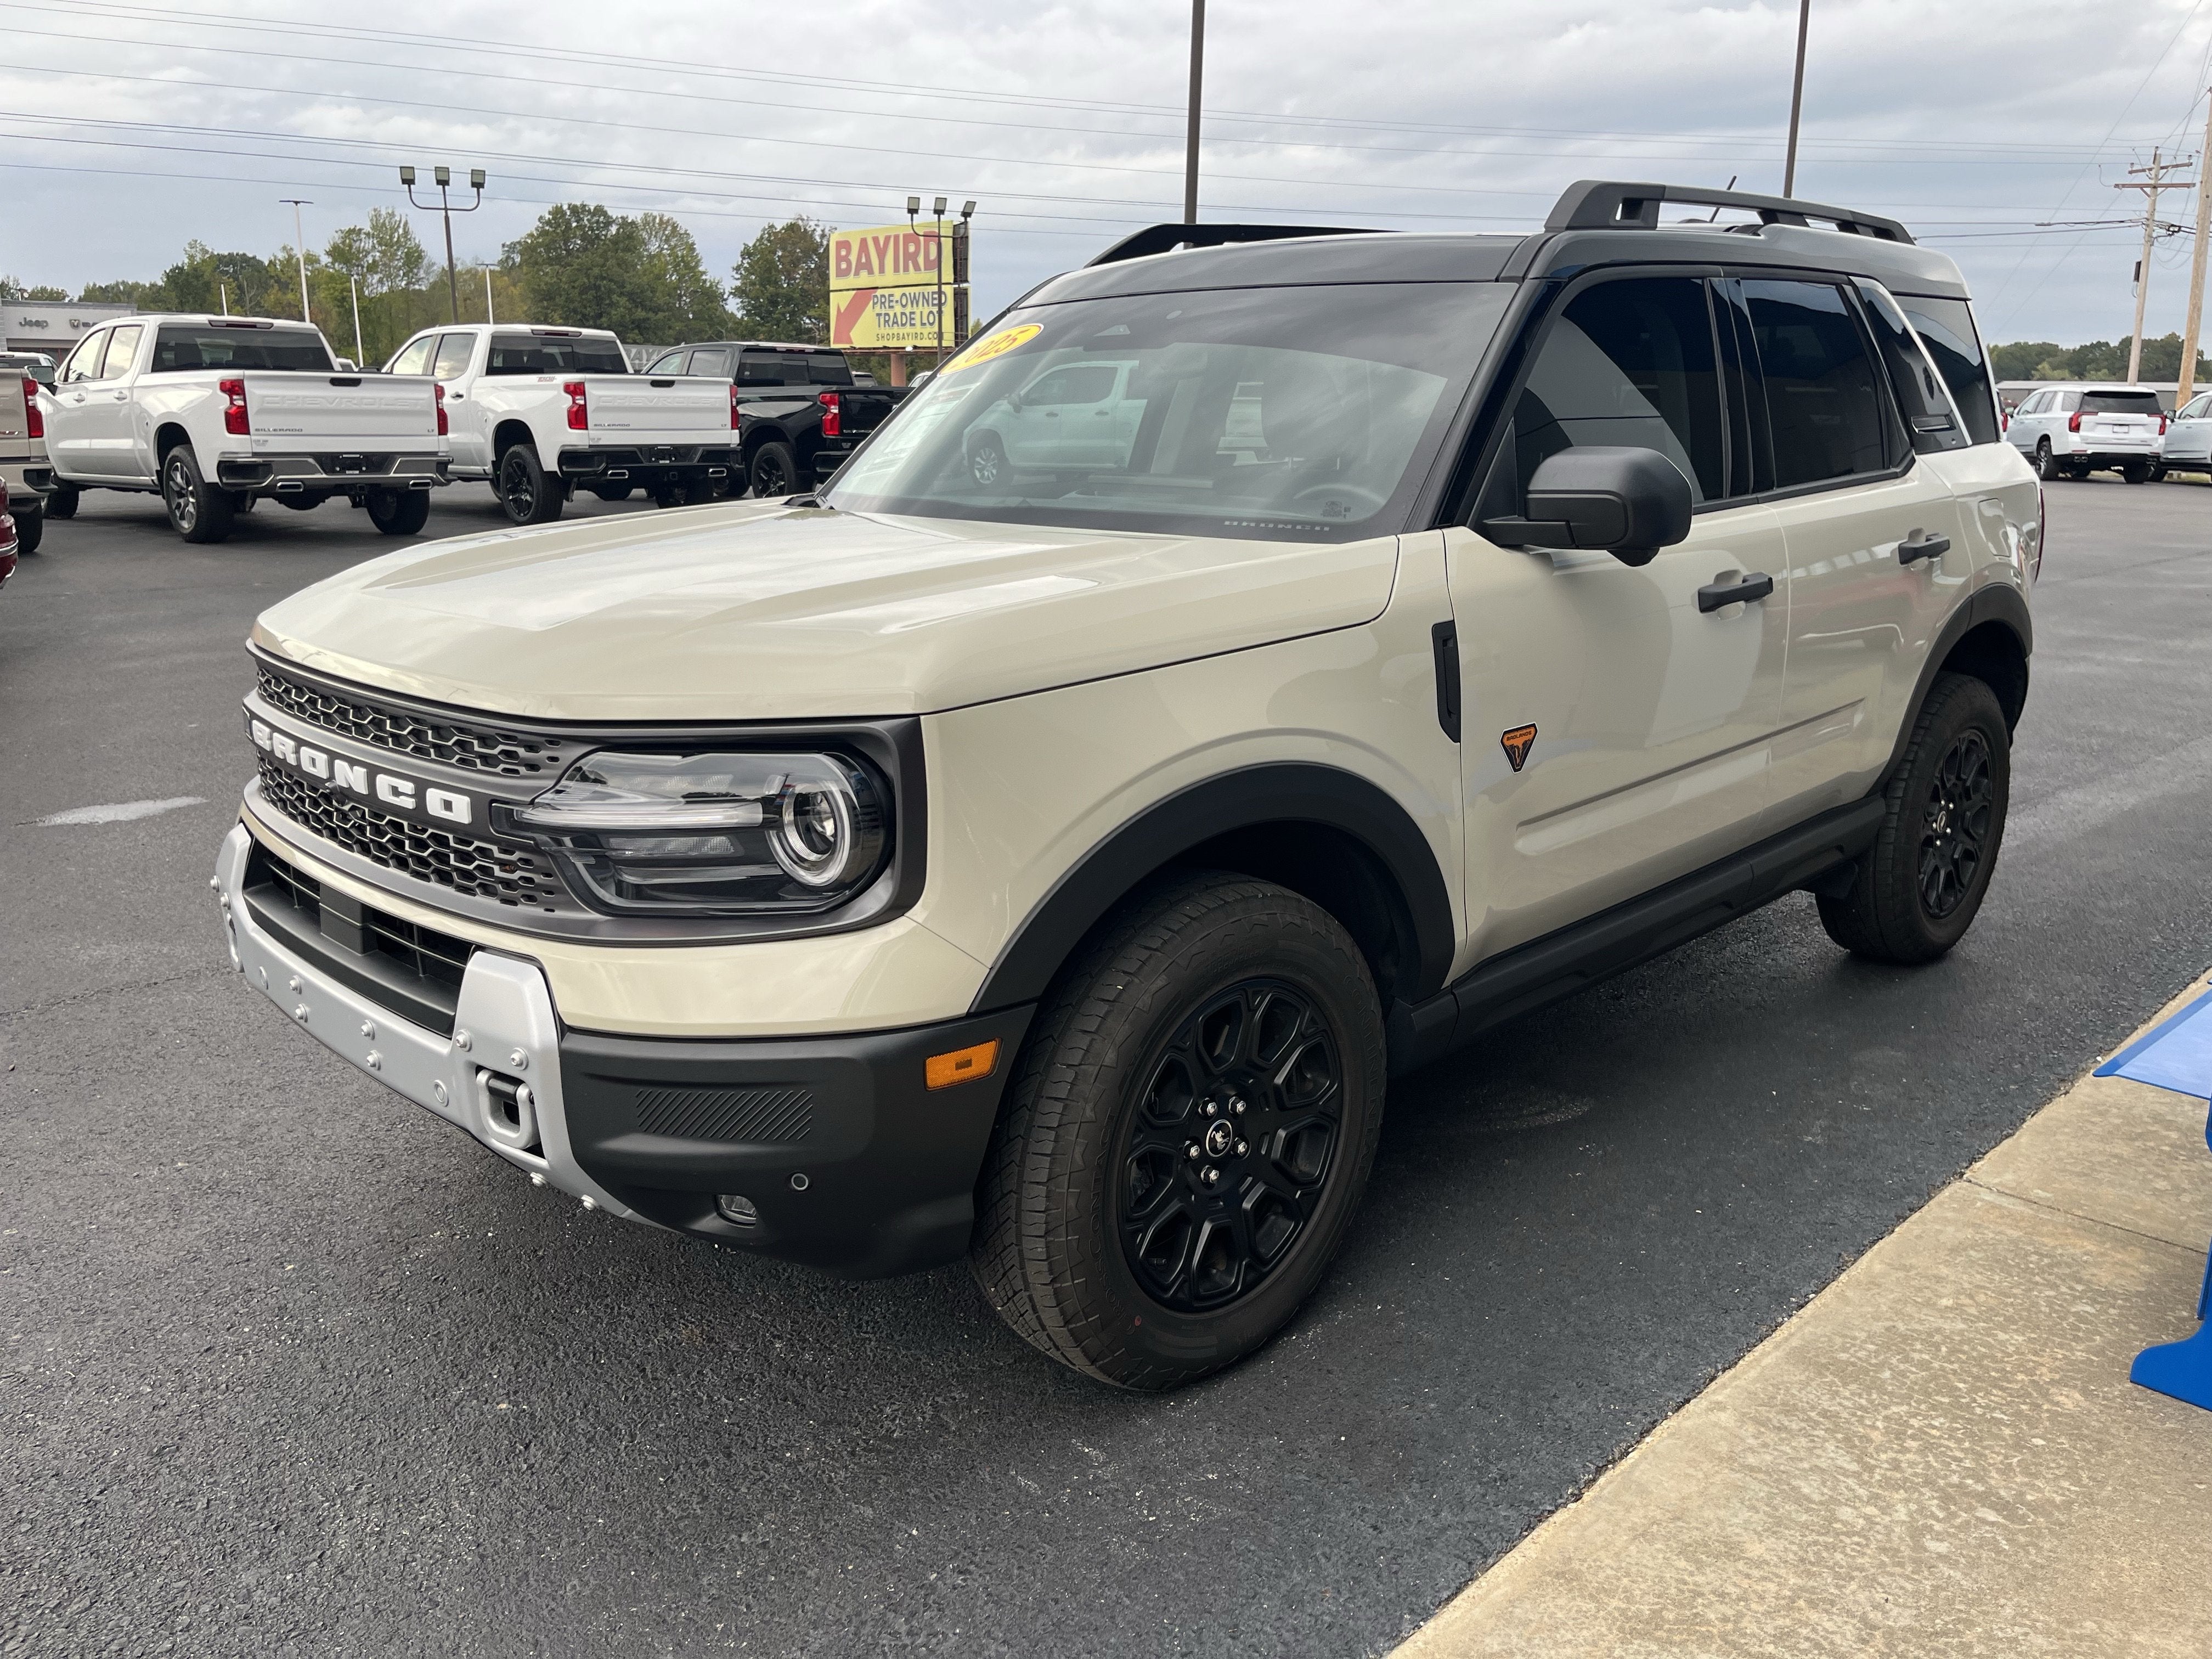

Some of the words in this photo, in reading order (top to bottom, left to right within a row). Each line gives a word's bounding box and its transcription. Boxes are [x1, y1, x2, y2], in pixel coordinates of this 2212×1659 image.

[836, 230, 942, 279] BAYIRD
[872, 291, 947, 310] PRE-OWNED
[19, 317, 48, 329] Jeep
[876, 311, 916, 328] TRADE
[876, 331, 943, 341] SHOPBAYIRD.CO
[948, 328, 1031, 371] 2025
[262, 395, 426, 409] CHEVROLET
[600, 395, 724, 406] CHEVROLET
[1506, 731, 1531, 741] BADLANDS
[252, 719, 472, 824] BRONCO
